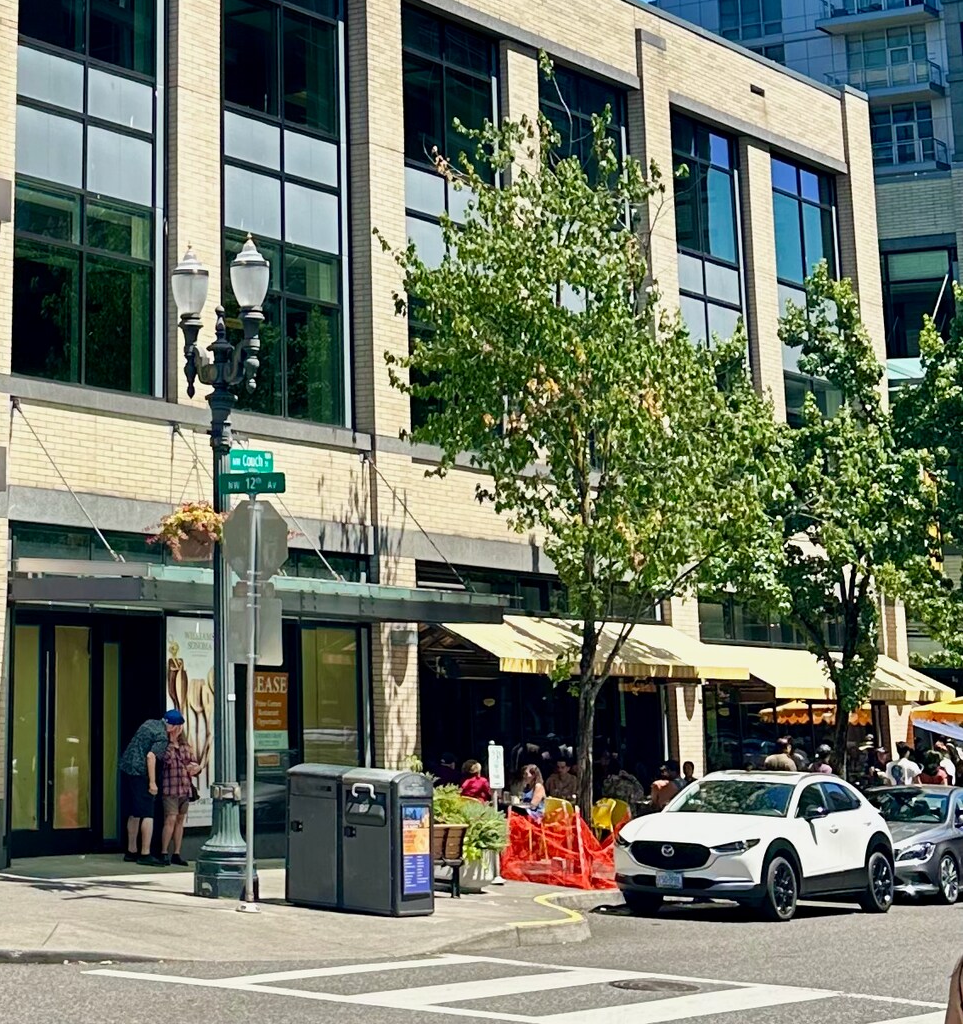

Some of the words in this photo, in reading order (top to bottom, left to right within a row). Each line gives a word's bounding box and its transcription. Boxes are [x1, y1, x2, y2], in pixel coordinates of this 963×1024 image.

[242, 454, 263, 467] Couch
[228, 481, 240, 489] NW
[245, 477, 262, 489] 12th
